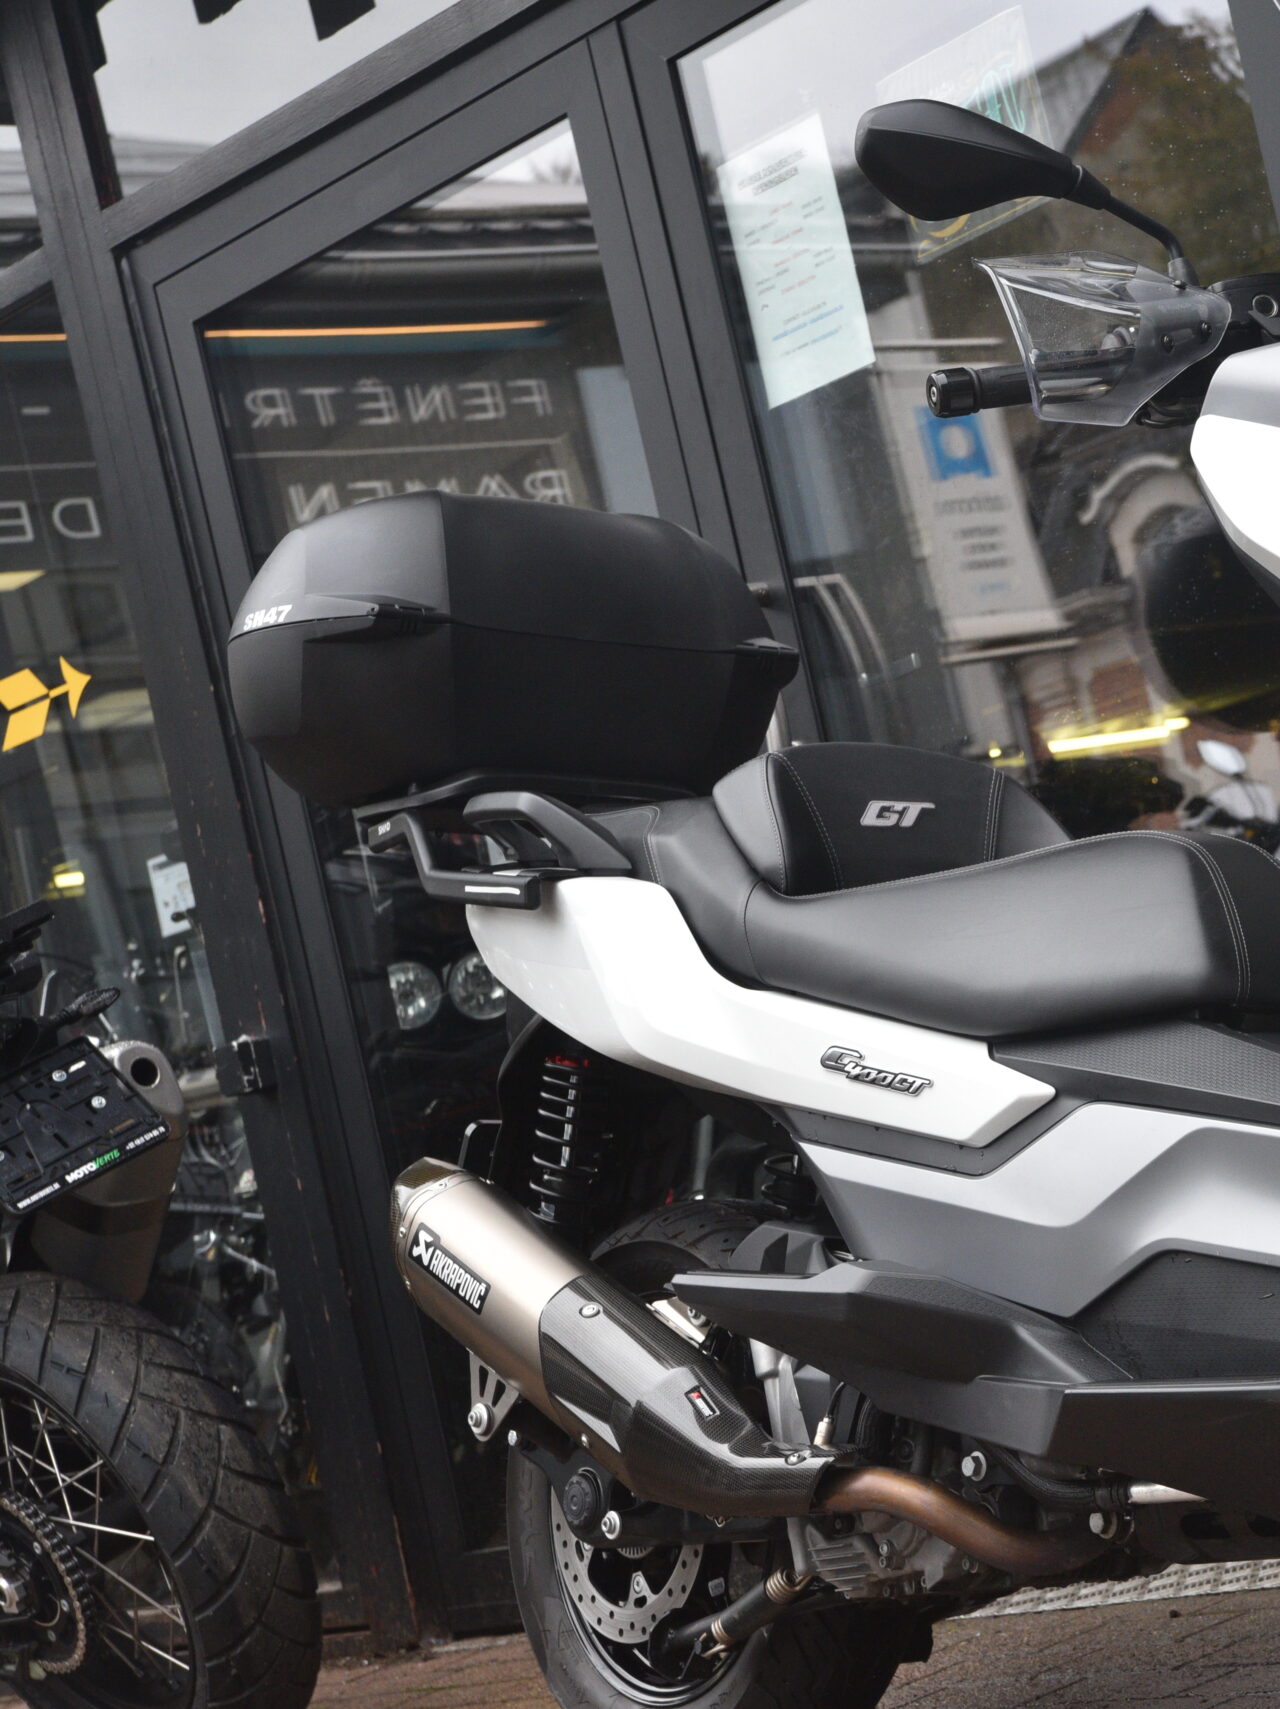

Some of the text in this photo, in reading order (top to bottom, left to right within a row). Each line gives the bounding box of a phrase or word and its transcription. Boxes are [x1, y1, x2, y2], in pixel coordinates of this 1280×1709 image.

[243, 604, 293, 631] SH47
[860, 800, 936, 828] GT
[429, 1247, 487, 1309] AKRAPOVIČ
